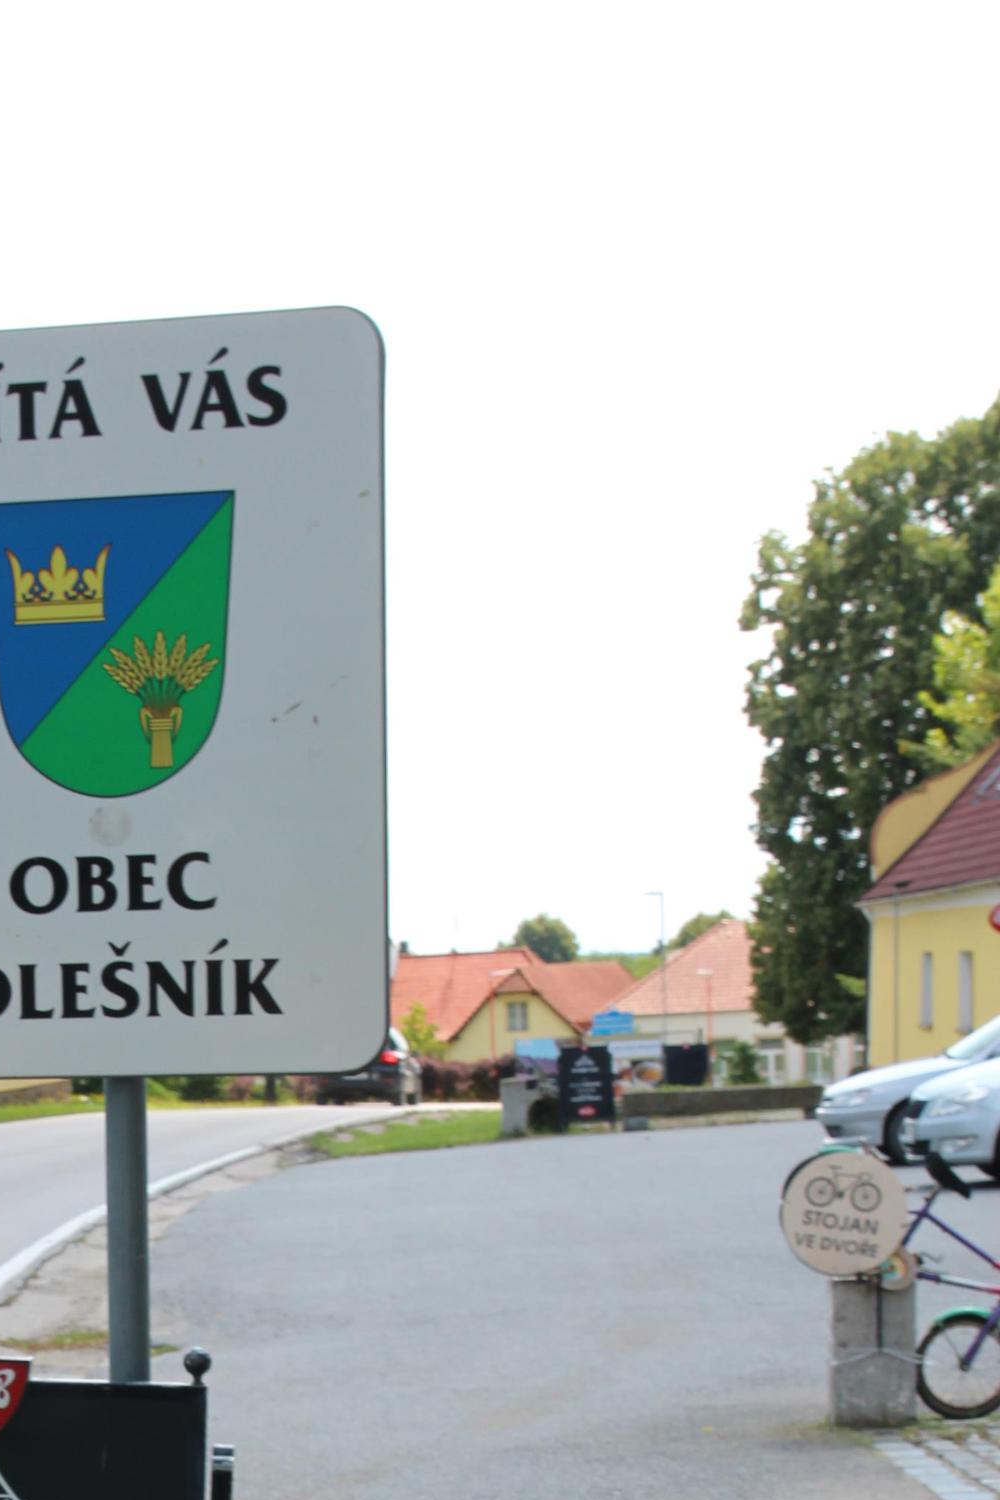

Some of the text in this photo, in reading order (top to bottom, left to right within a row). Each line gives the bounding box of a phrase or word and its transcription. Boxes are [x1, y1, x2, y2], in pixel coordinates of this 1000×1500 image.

[141, 347, 287, 432] VÁS
[9, 851, 217, 915] OBEC
[794, 1232, 817, 1249] VE
[802, 1209, 880, 1236] STOJAN
